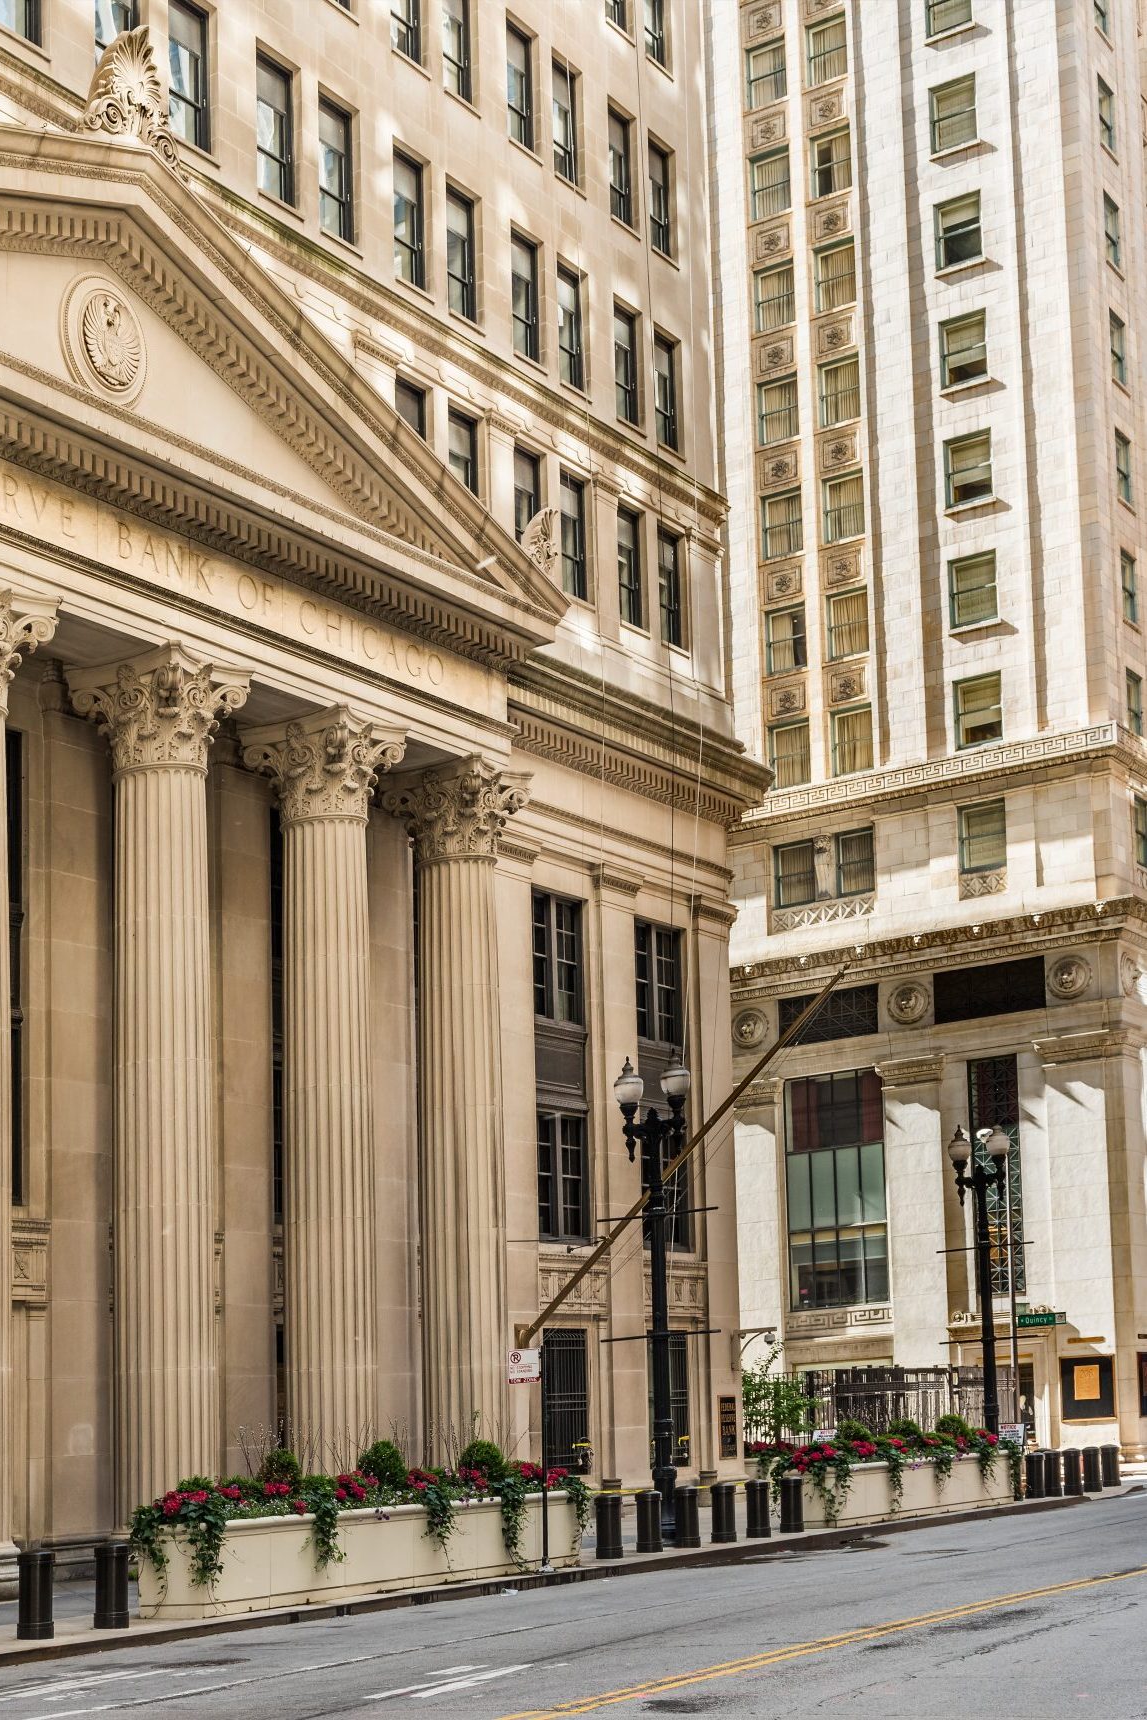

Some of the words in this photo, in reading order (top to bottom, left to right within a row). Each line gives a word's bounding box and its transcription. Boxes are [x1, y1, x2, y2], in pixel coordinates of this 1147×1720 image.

[116, 519, 216, 596] BANK
[236, 573, 278, 617] OF
[298, 600, 446, 686] CHICAGO
[1025, 1316, 1048, 1324] Quincy
[722, 1424, 736, 1436] BANK
